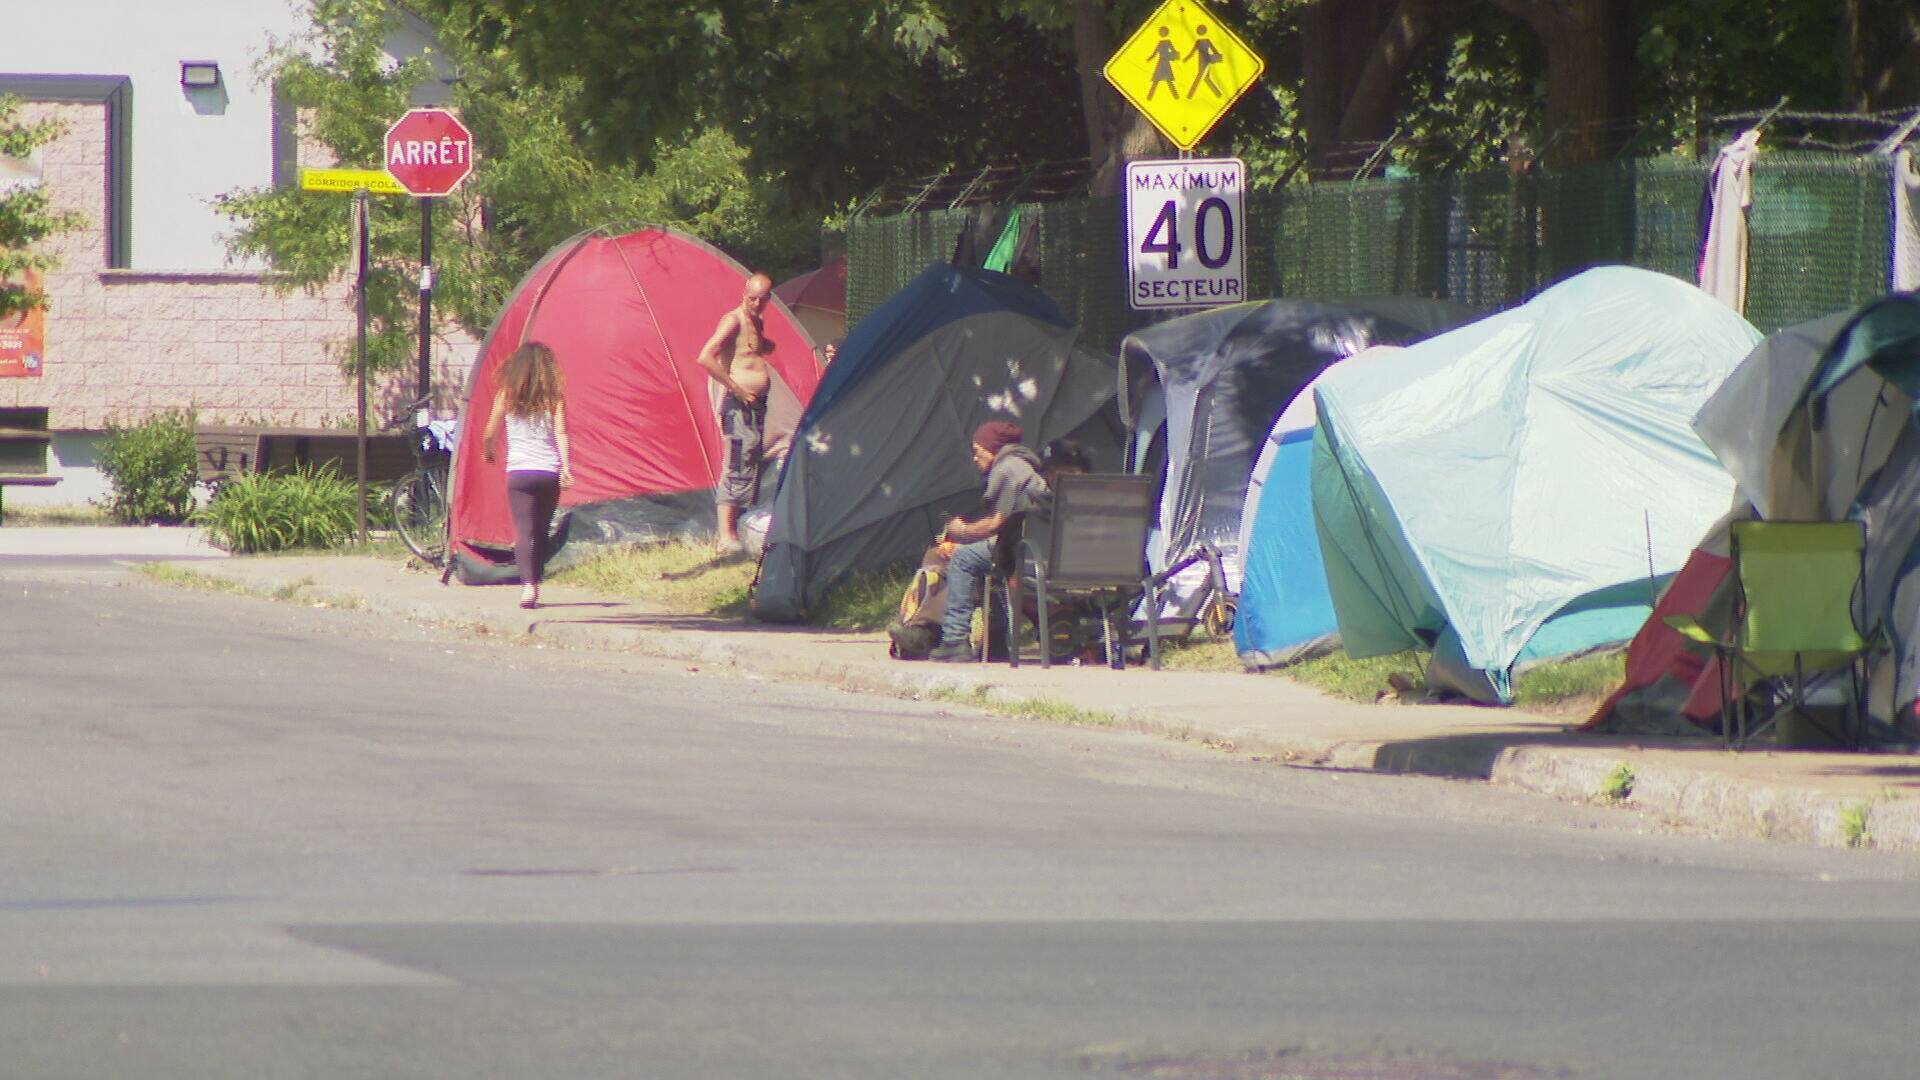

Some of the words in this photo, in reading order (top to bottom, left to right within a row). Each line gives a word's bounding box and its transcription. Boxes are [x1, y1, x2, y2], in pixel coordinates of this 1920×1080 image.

[391, 137, 467, 164] ARRÊT
[308, 178, 360, 188] CORRIDOR
[1136, 172, 1235, 190] MAXIMUM
[1141, 197, 1233, 269] 40
[1138, 279, 1239, 298] SECTEUR
